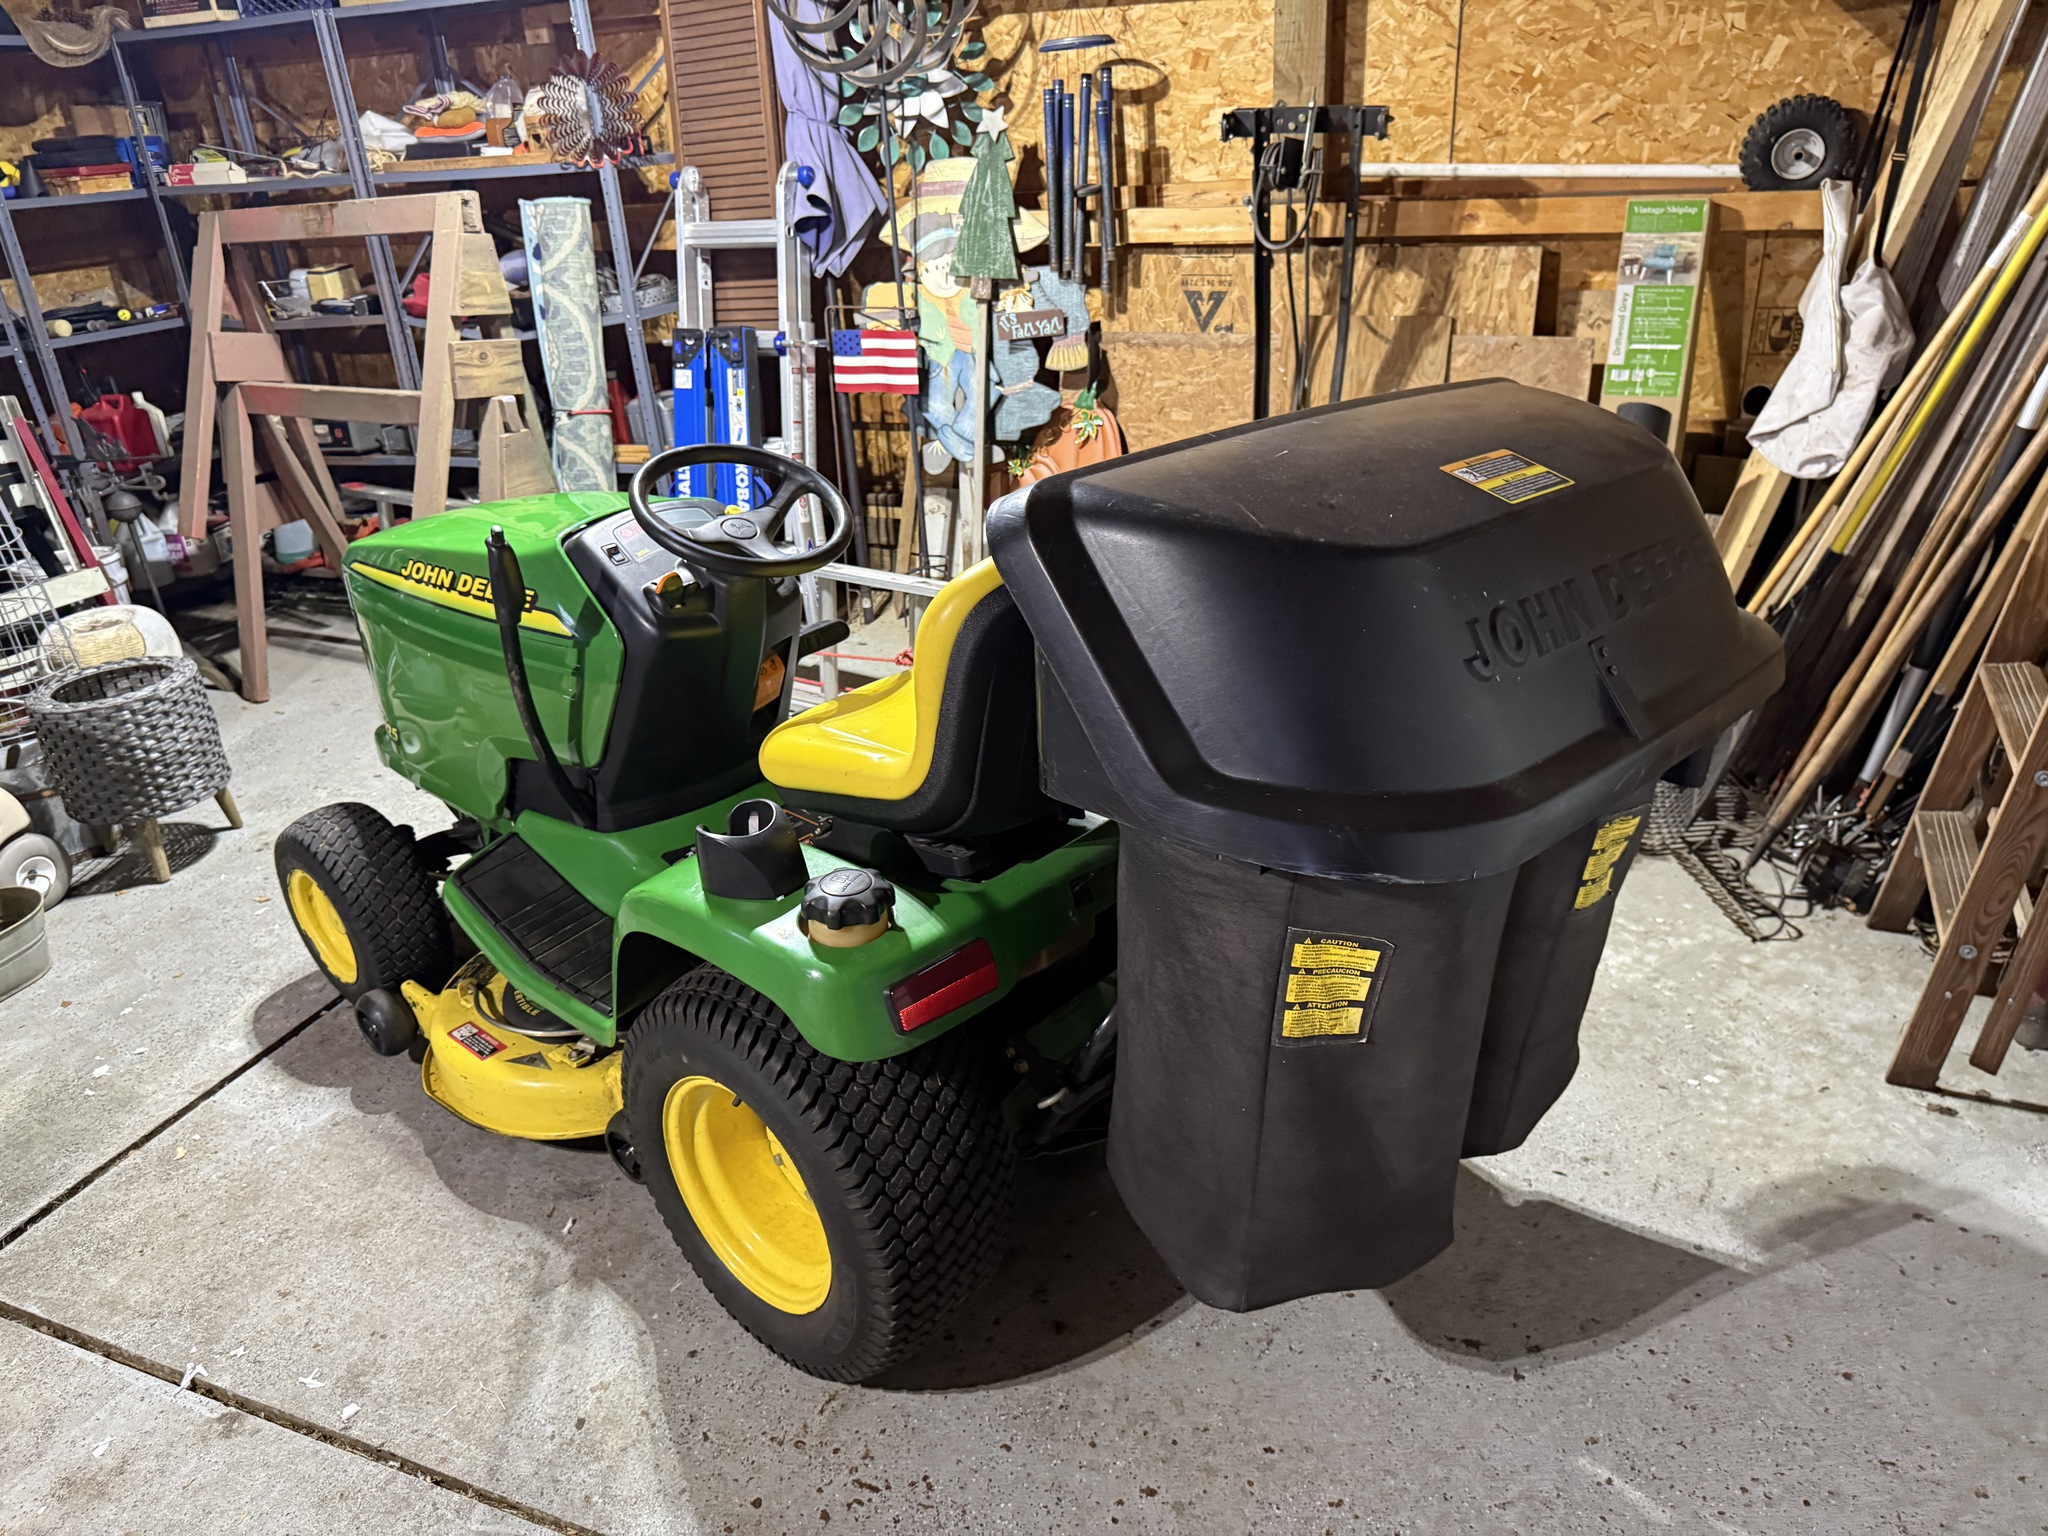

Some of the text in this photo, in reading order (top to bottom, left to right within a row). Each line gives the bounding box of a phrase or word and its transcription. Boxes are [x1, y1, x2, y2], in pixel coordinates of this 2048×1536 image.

[1633, 205, 1698, 216] Vintage Shiplap
[1613, 293, 1630, 356] Driftwood Grey
[401, 560, 537, 609] JOHN DEE
[1463, 577, 1597, 683] JOHN
[1320, 938, 1359, 948] CAUTION
[1307, 1001, 1349, 1010] ATTENTION
